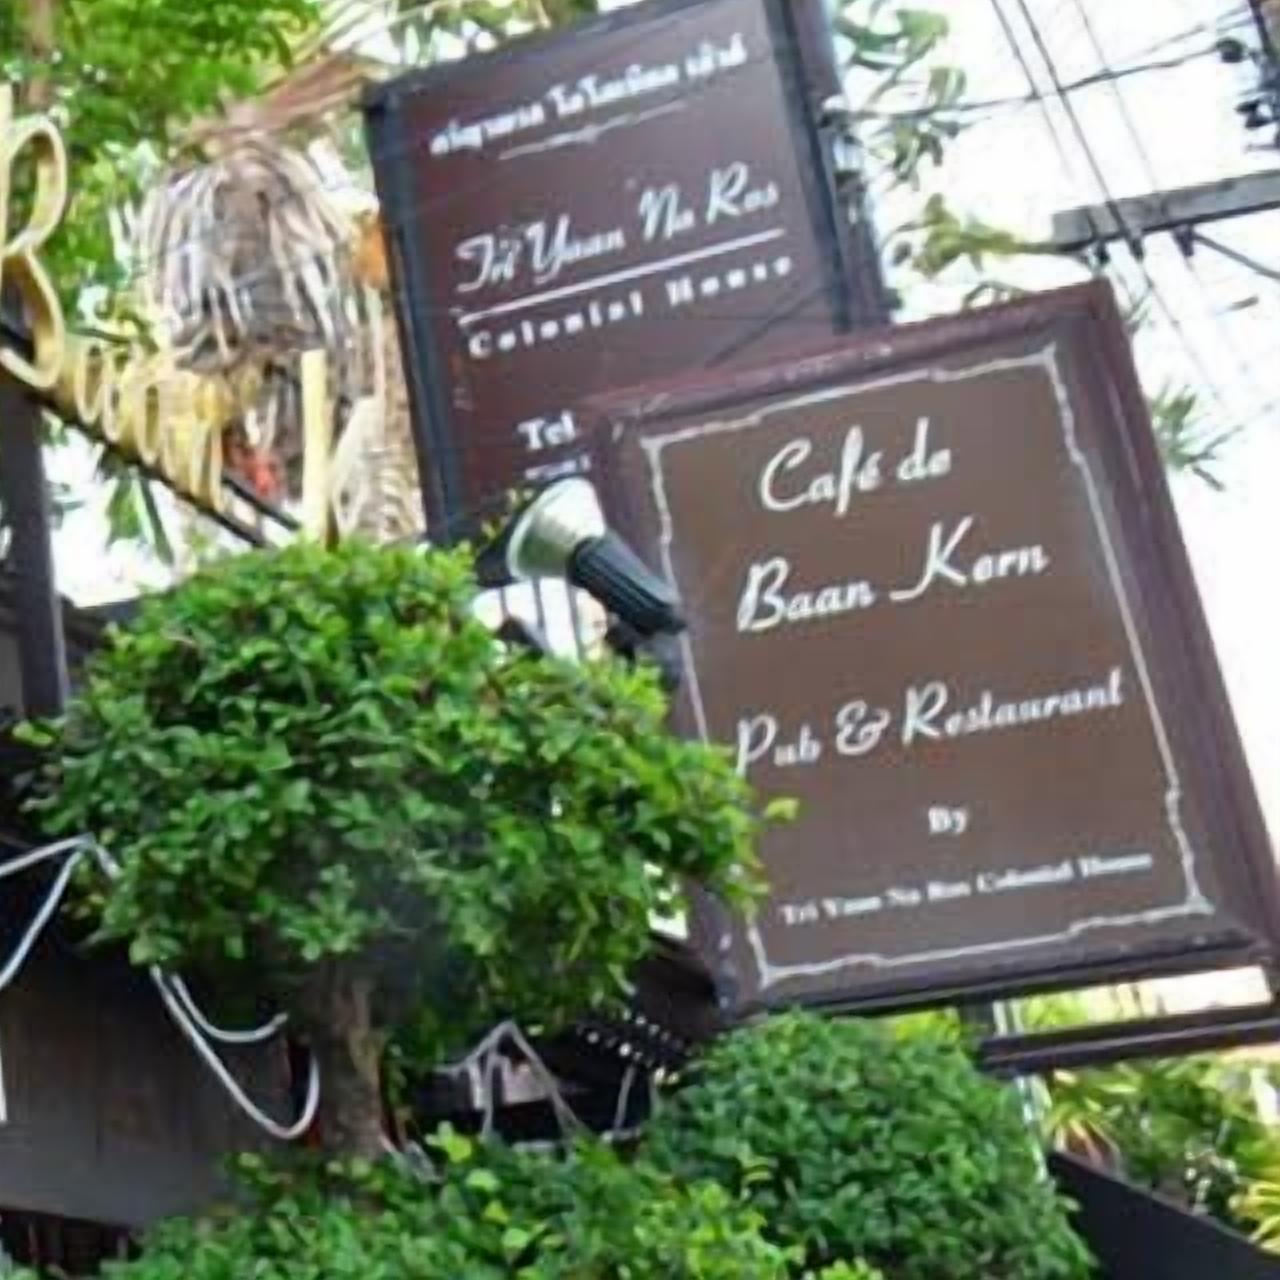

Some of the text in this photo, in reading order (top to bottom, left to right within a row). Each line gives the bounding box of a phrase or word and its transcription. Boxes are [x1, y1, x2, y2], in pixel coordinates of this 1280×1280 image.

[896, 418, 952, 479] de
[737, 517, 1050, 631] Baan Kern
[735, 668, 1124, 777] Pub & Restaurant
